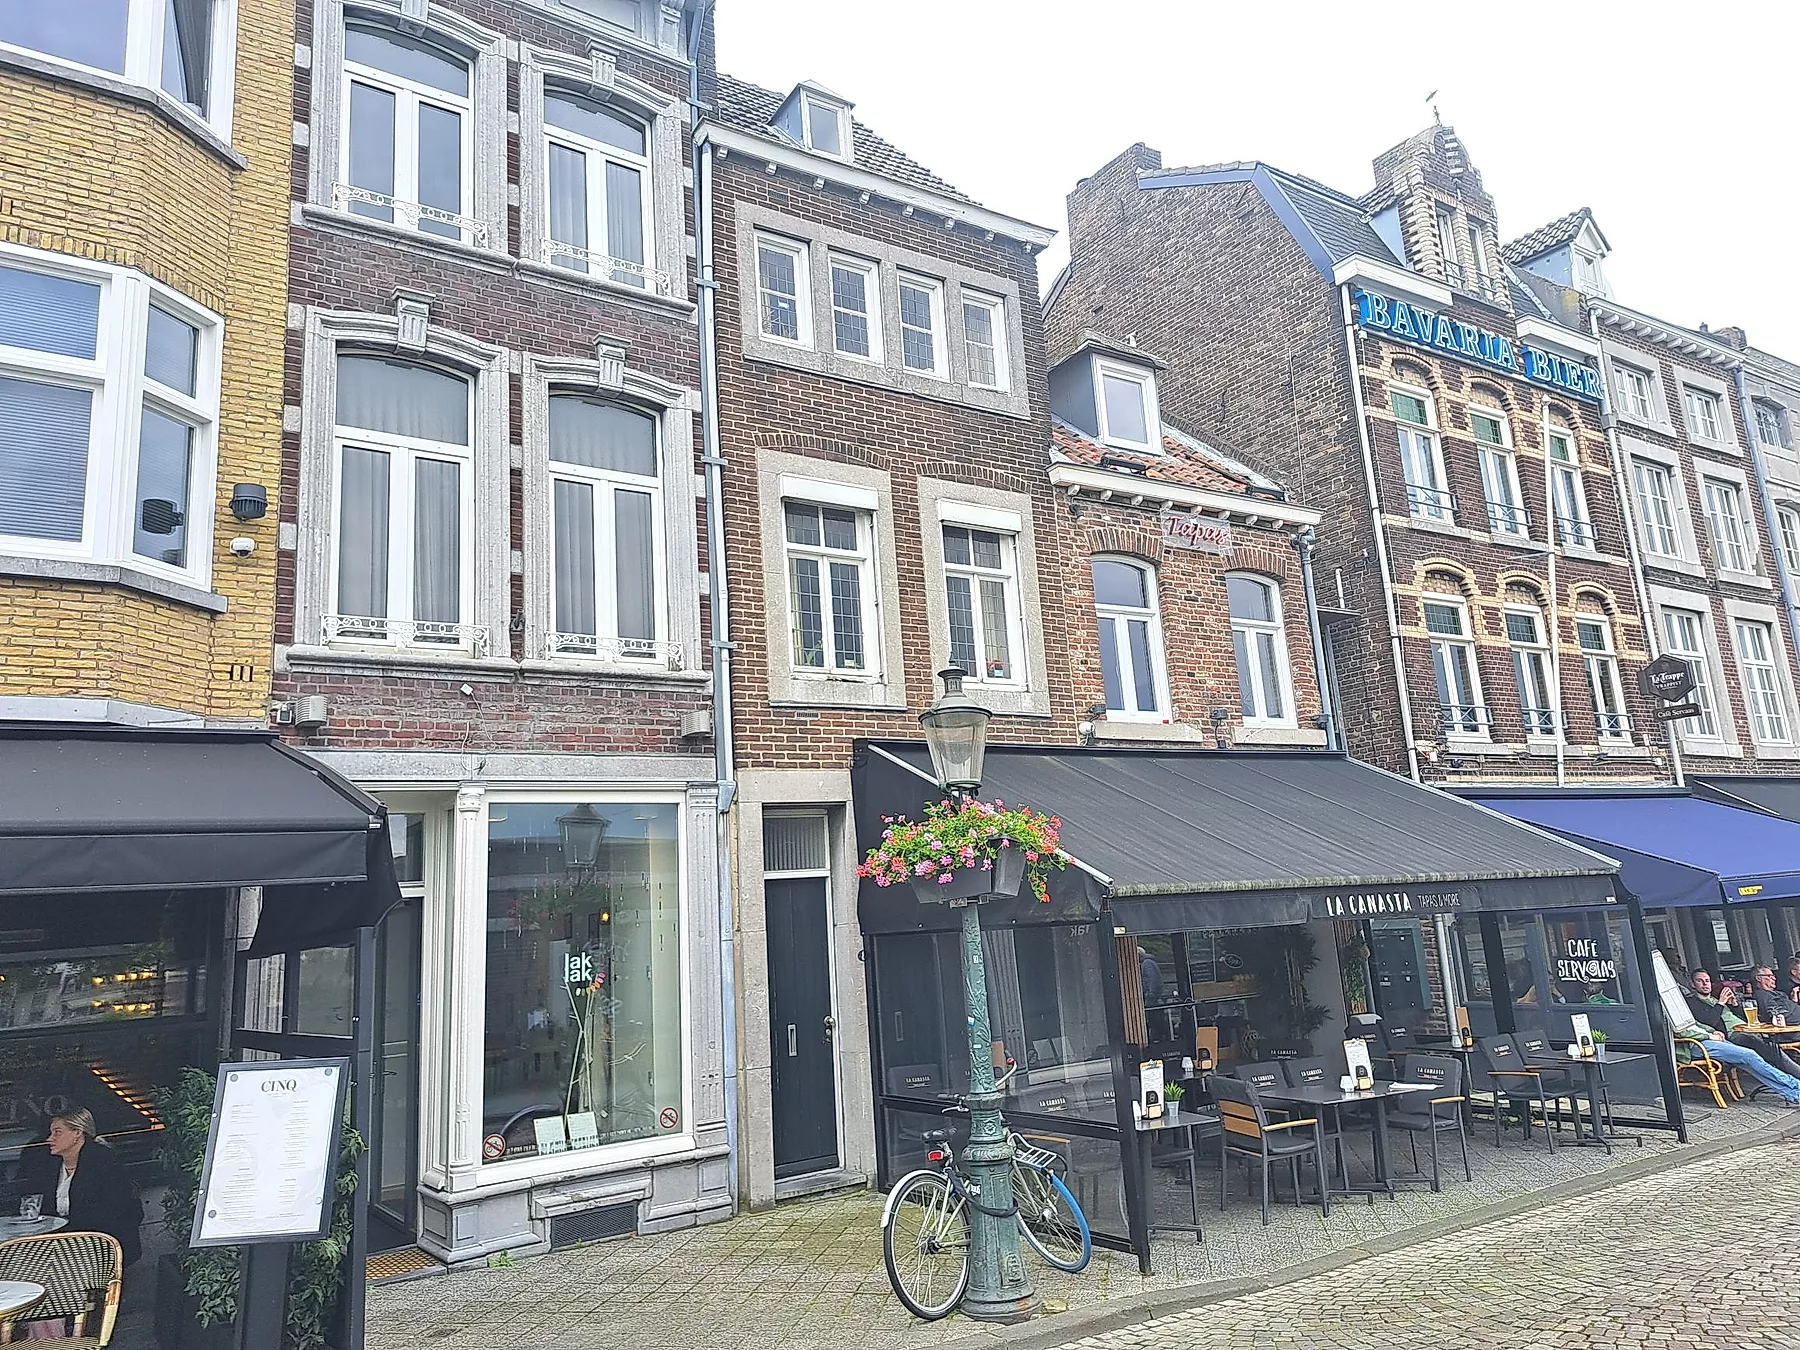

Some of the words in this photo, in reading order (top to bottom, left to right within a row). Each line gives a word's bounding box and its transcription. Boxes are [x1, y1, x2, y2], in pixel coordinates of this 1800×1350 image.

[1358, 288, 1519, 371] BAVARIA
[1526, 346, 1604, 400] BIER
[1163, 515, 1229, 545] Tapas
[1660, 671, 1685, 684] Trappe
[1326, 895, 1345, 916] LA
[1349, 892, 1412, 915] CANASTA
[1417, 894, 1438, 908] TAPAS
[1443, 893, 1460, 907] MORE
[1567, 939, 1598, 957] CAFÉ
[261, 1079, 298, 1093] CINQ
